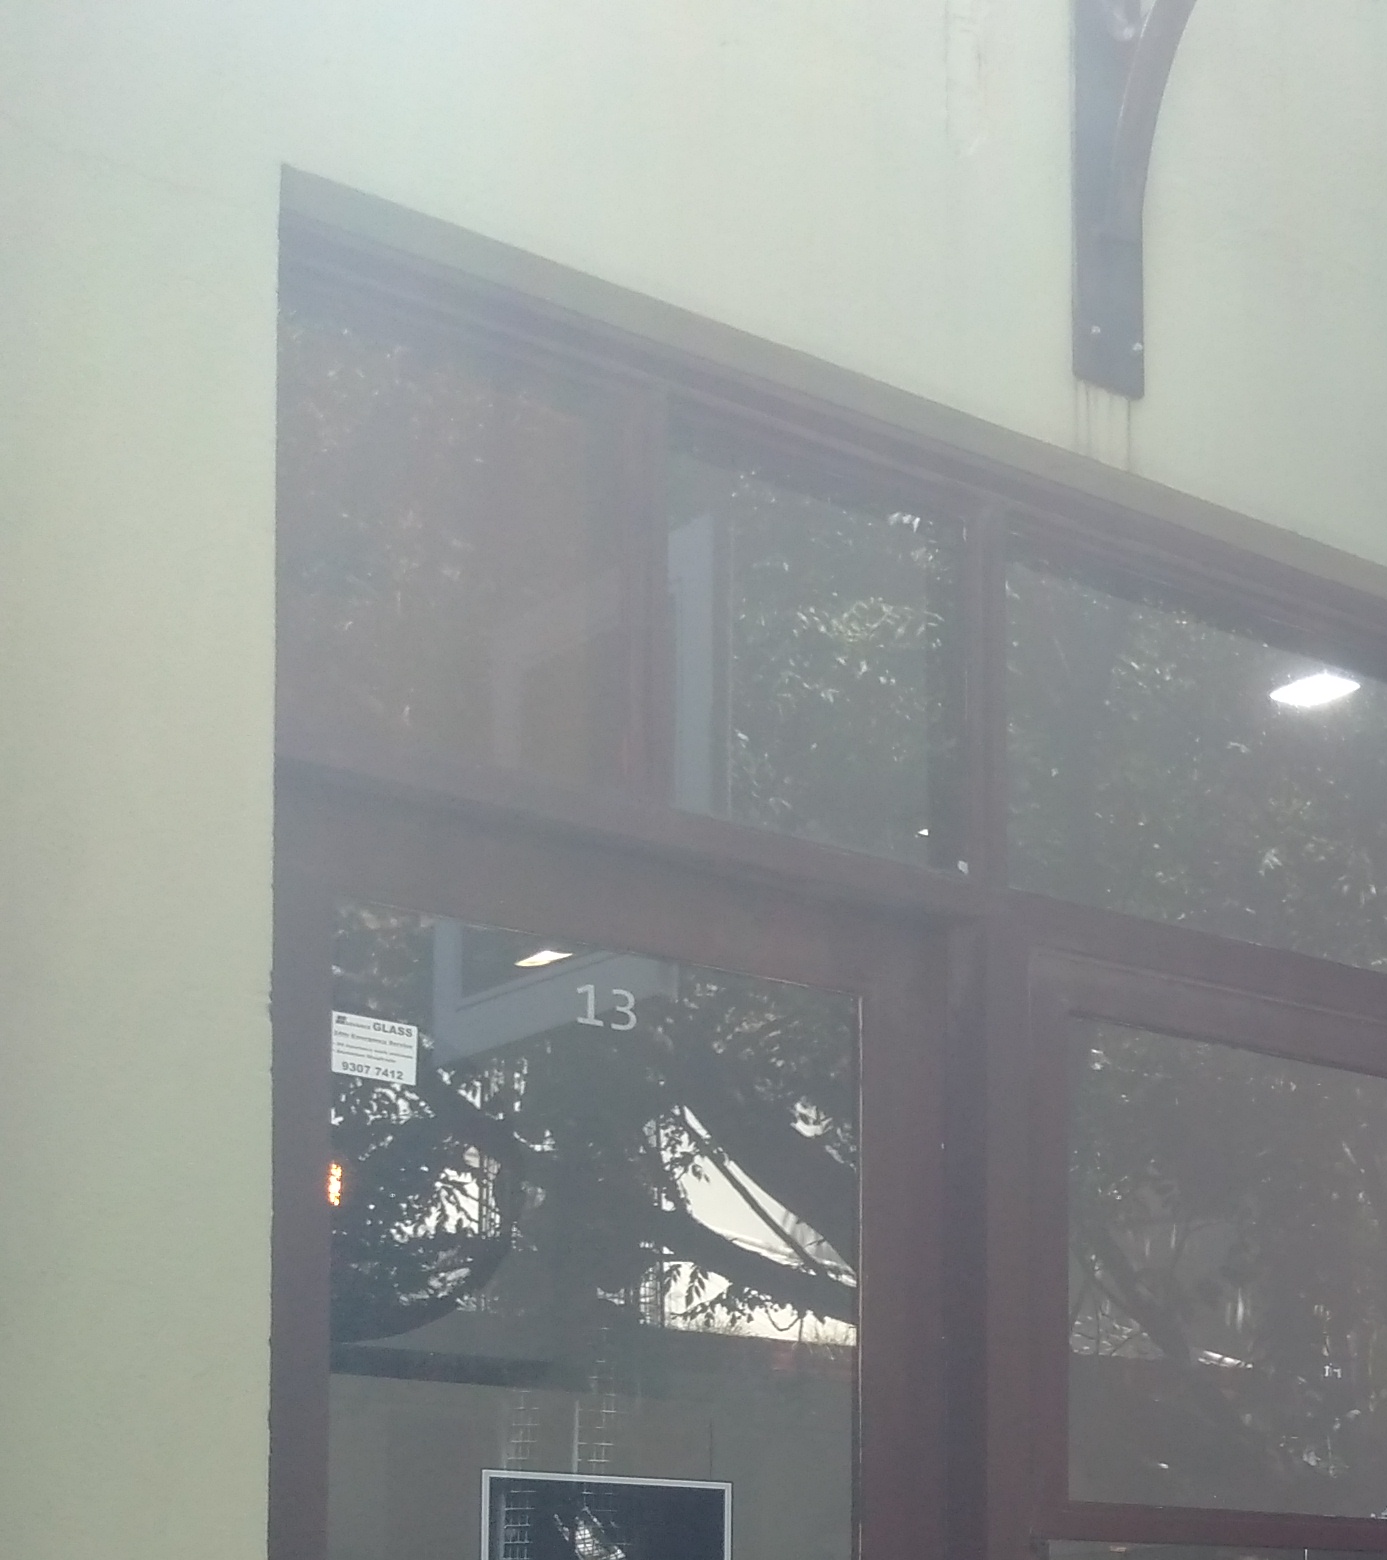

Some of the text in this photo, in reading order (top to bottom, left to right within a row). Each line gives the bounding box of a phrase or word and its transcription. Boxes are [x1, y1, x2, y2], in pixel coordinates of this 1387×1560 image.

[576, 984, 637, 1031] 13
[372, 1022, 413, 1038] GLASS
[341, 1061, 404, 1080] 9307 7412
